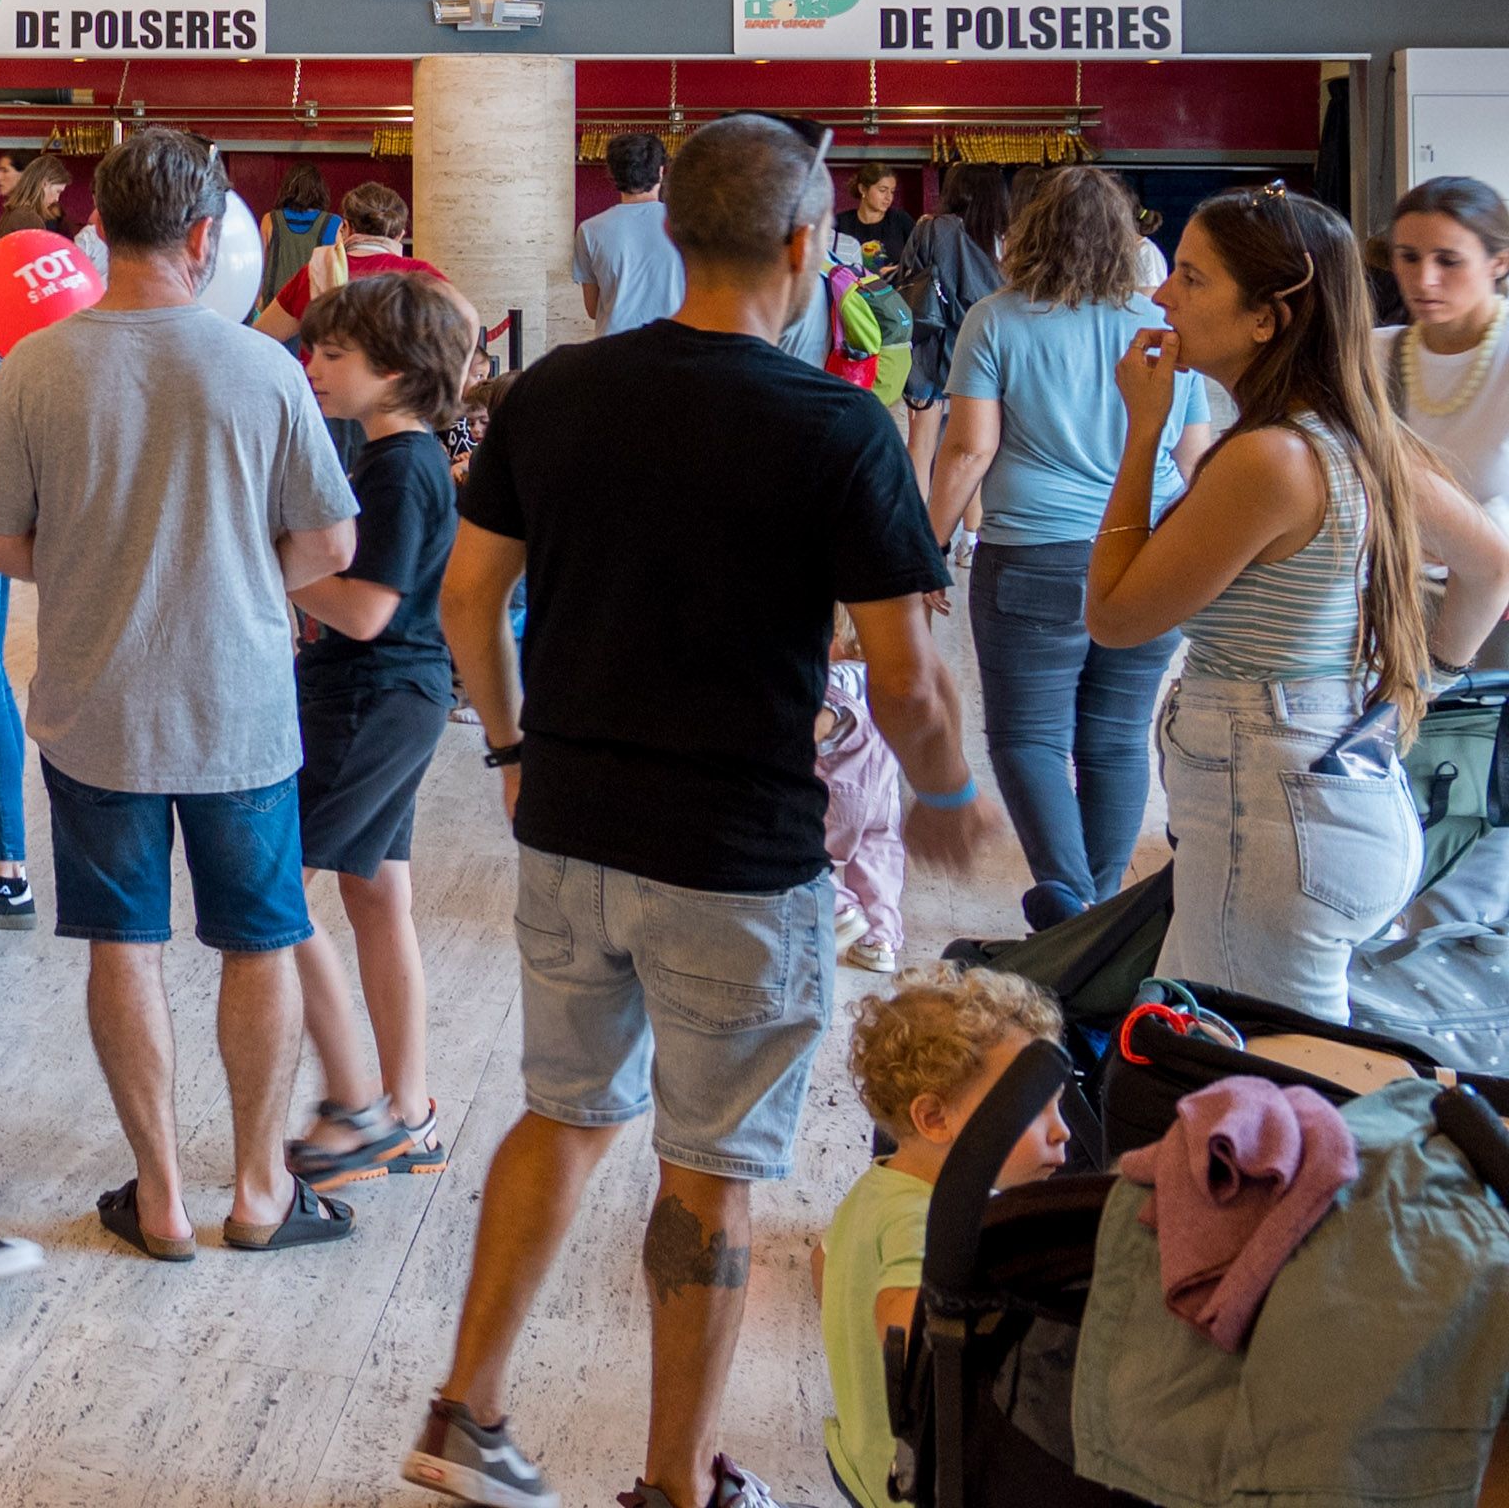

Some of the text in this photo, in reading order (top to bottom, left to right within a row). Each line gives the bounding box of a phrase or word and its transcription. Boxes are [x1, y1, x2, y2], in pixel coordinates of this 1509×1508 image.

[16, 9, 257, 50] DE POLSERES
[880, 5, 1172, 50] DE POLSERES
[13, 248, 77, 289] TOT
